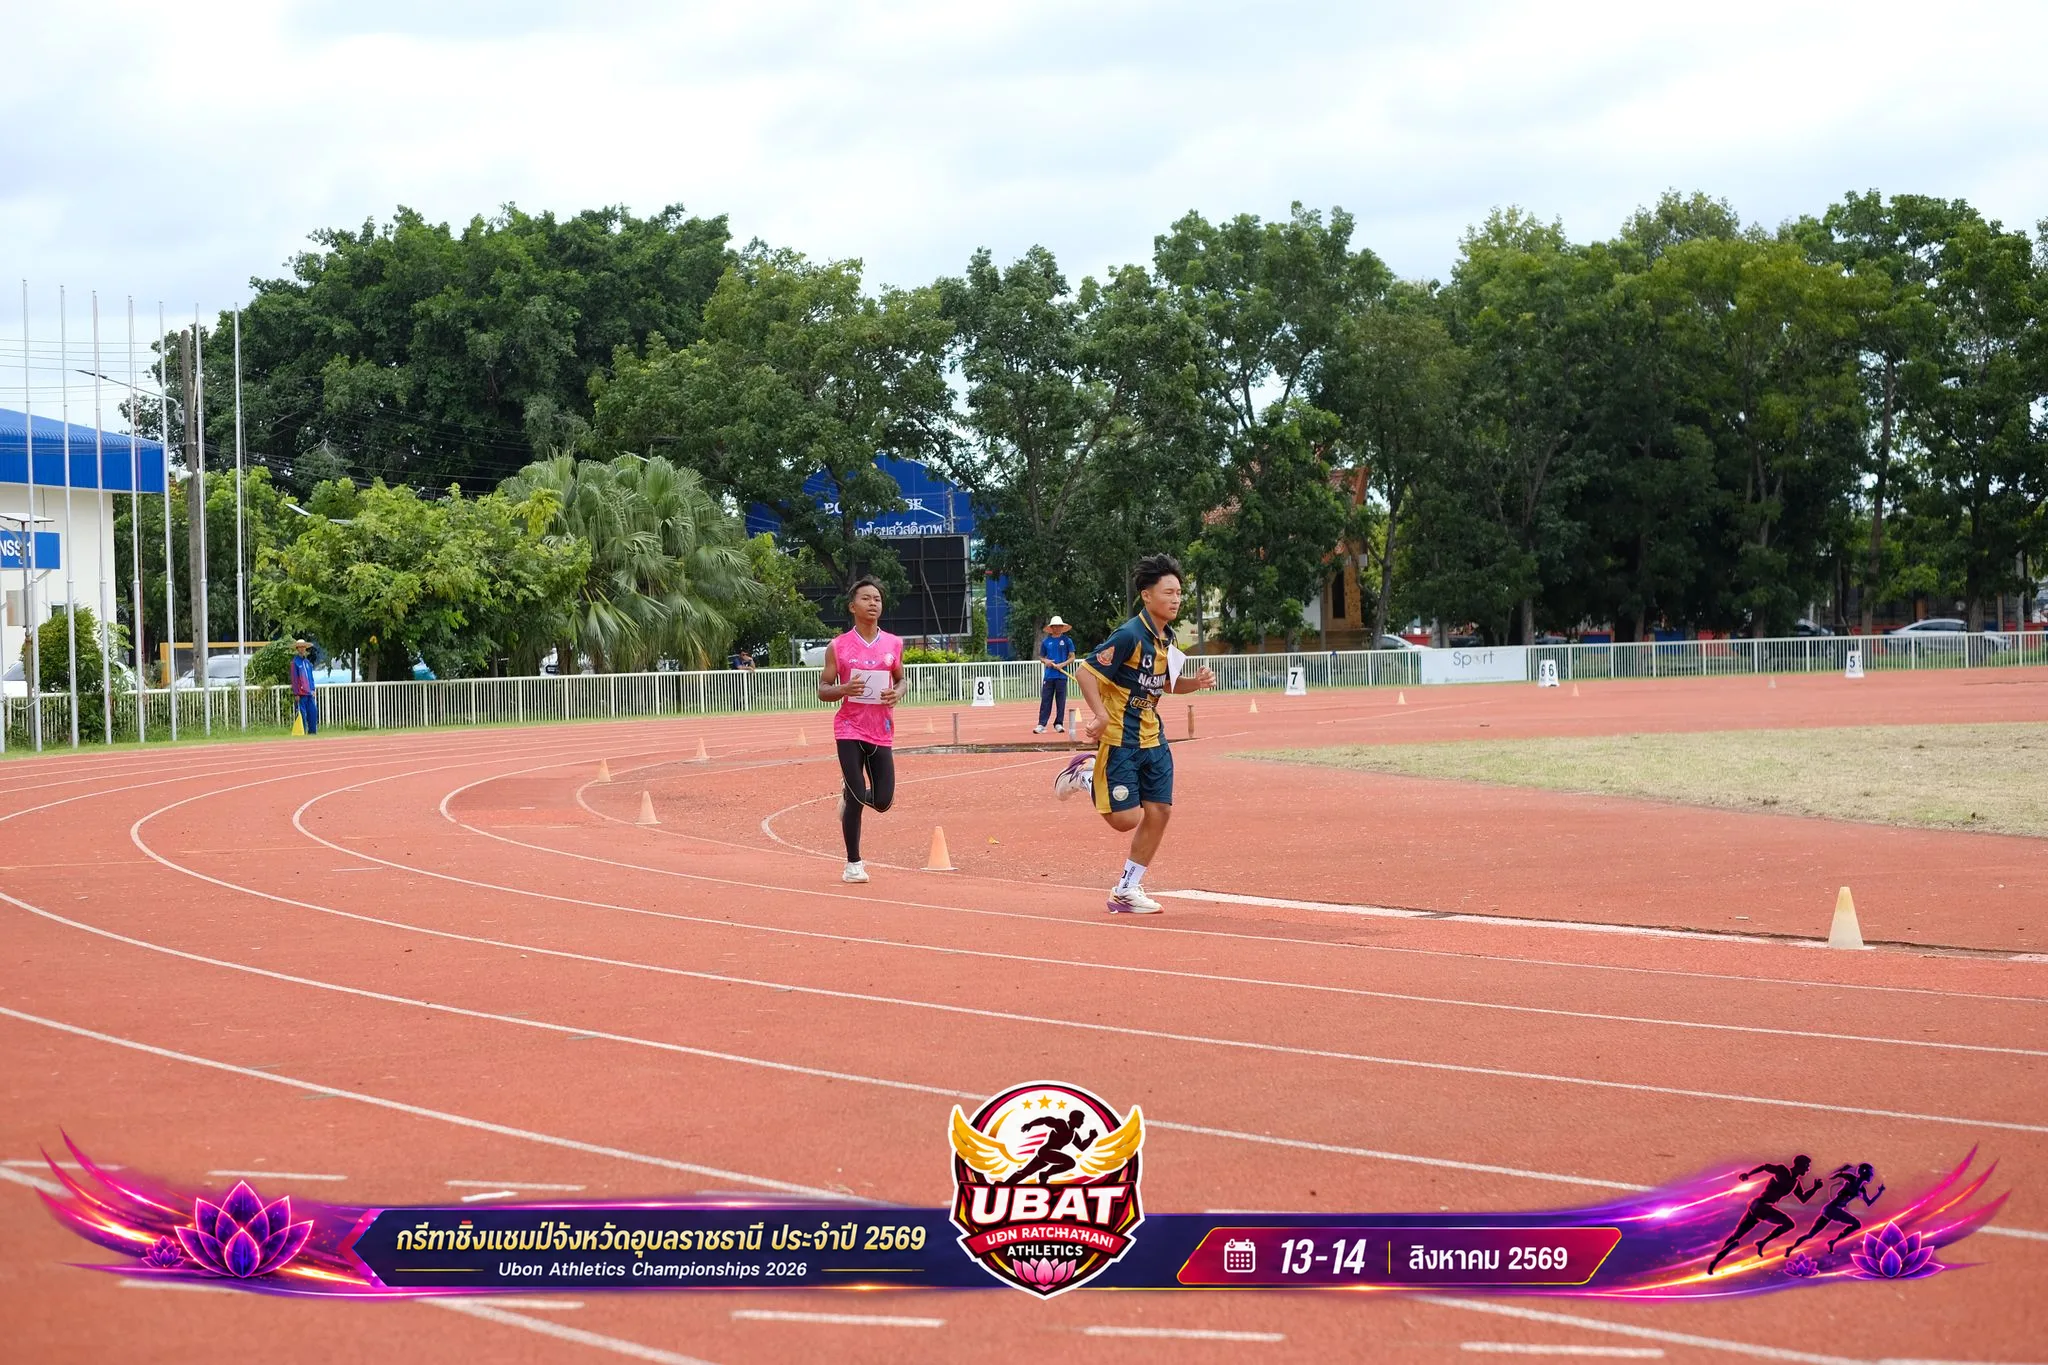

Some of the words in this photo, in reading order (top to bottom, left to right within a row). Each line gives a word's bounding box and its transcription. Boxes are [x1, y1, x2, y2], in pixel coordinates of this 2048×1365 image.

[1849, 655, 1856, 669] 5
[1548, 664, 1554, 677] 6
[1290, 671, 1298, 685] 7
[977, 681, 985, 695] 8
